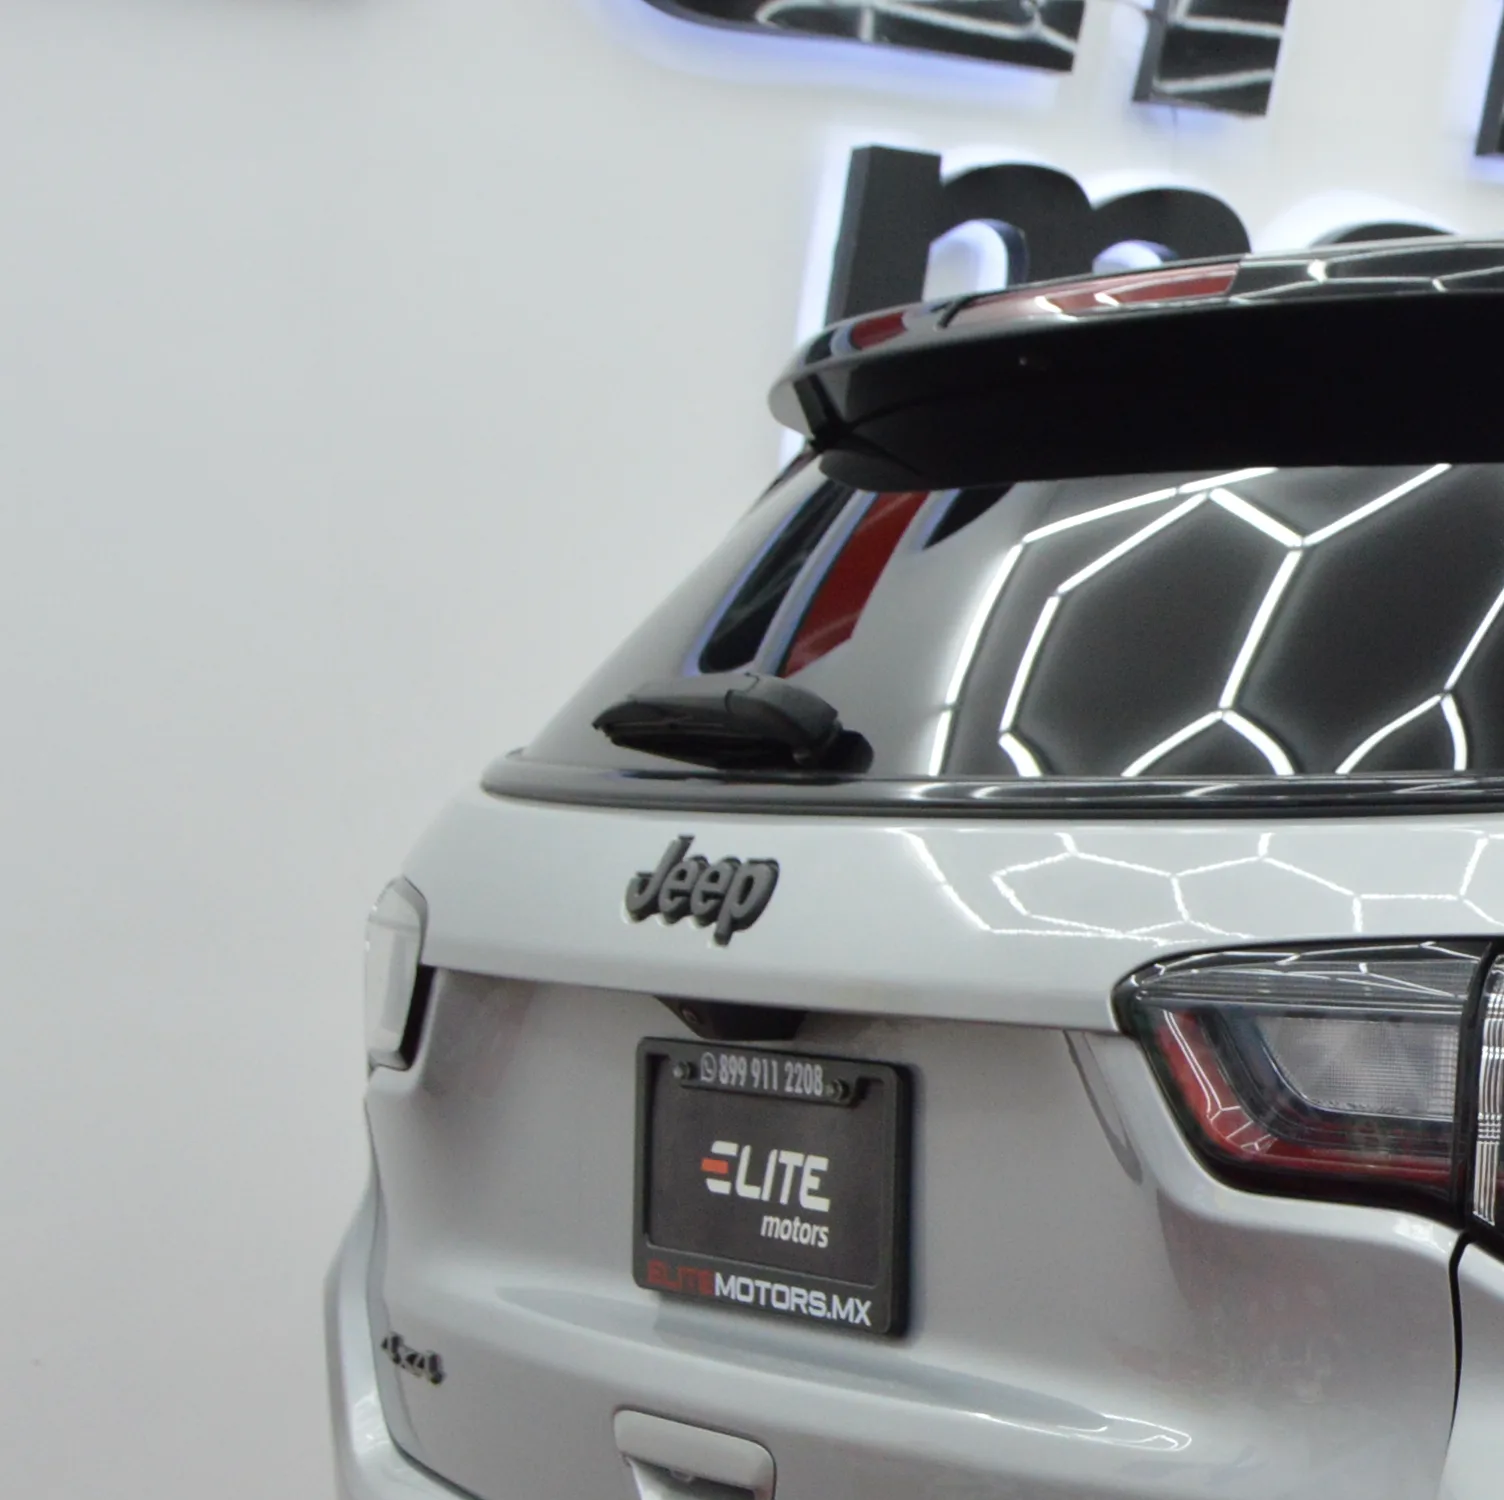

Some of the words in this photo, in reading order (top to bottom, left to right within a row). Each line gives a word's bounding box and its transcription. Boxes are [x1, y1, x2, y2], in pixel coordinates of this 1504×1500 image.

[625, 834, 780, 947] Jeep
[718, 1054, 748, 1087] 899
[751, 1057, 779, 1092] 911
[784, 1061, 824, 1097] 2208
[701, 1140, 830, 1212] ELITE
[760, 1215, 829, 1248] motors
[646, 1259, 872, 1327] ELITEMOTORS.MX
